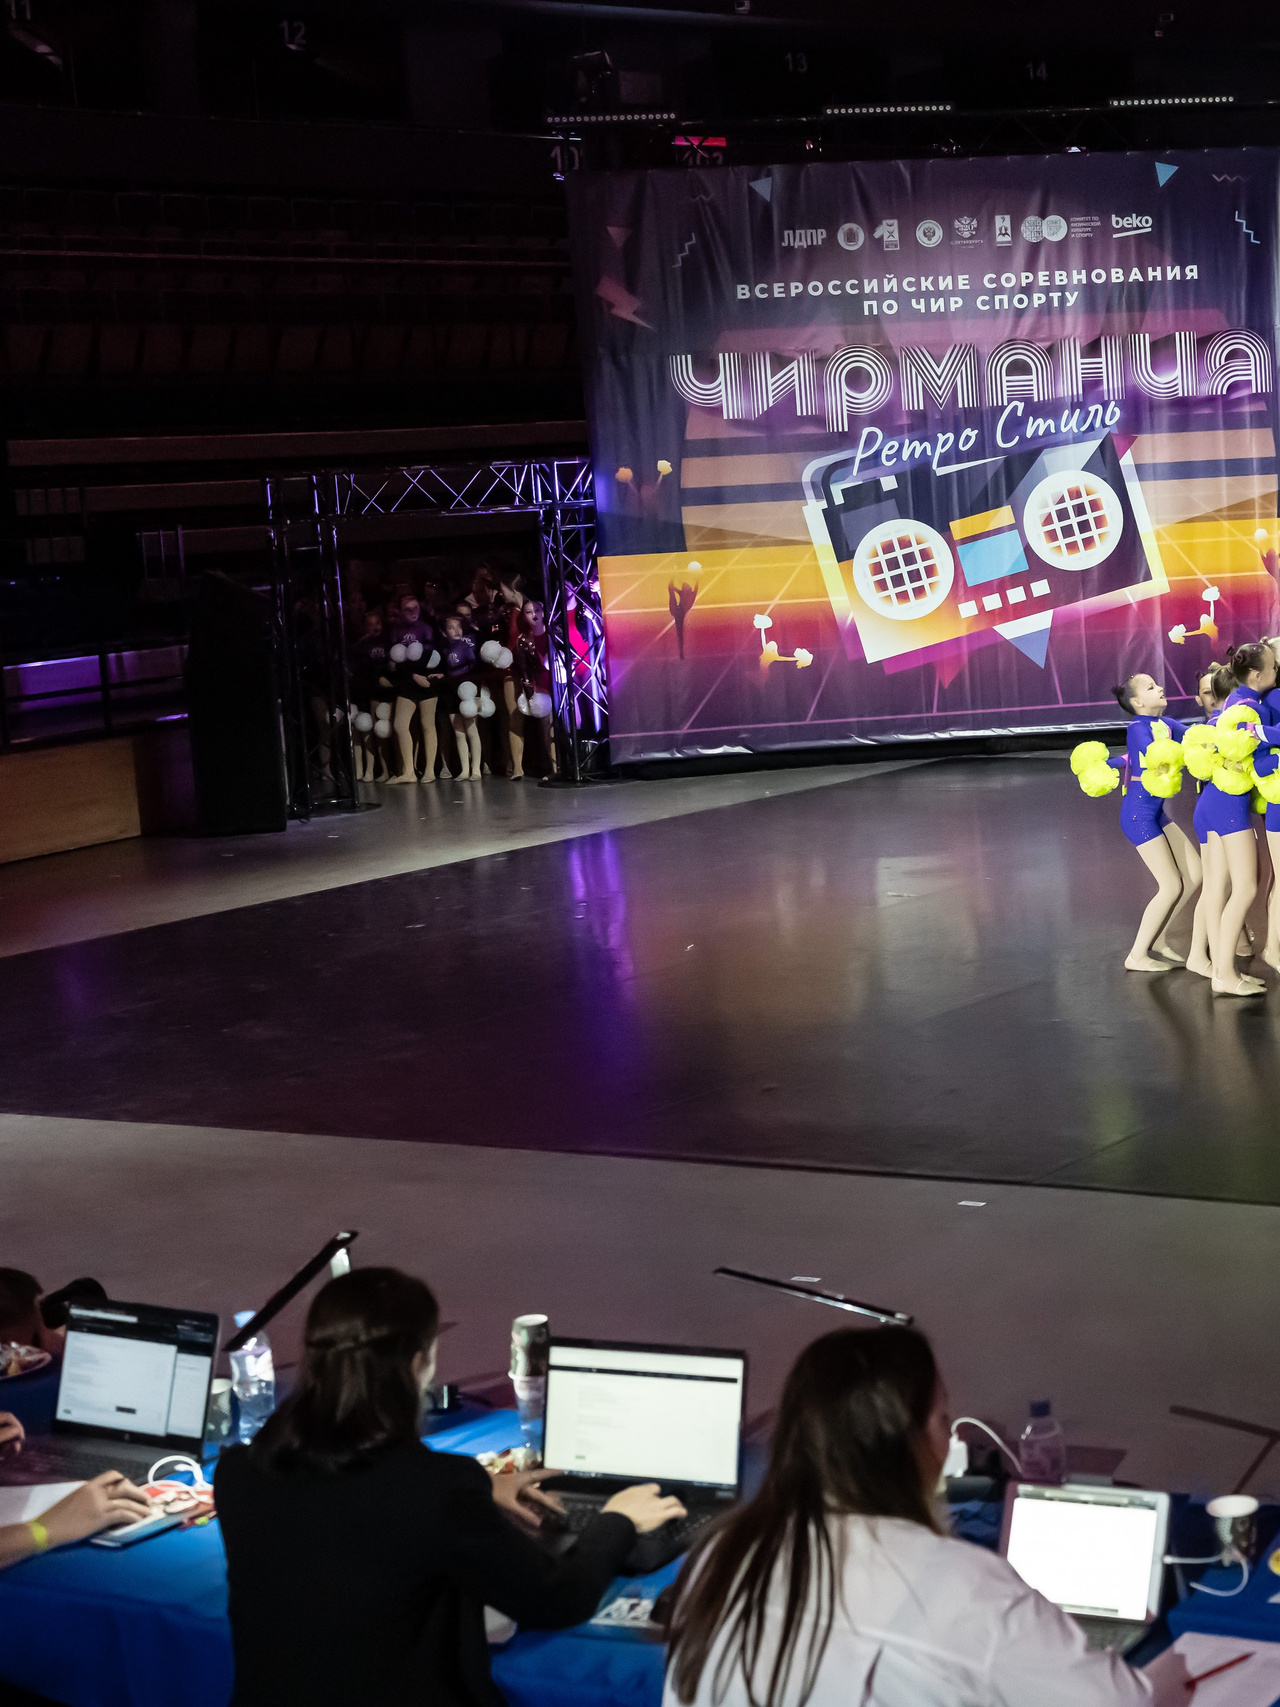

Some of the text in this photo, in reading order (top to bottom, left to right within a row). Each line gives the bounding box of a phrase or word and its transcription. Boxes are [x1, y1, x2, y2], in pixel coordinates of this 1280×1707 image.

[280, 20, 306, 44] 12
[785, 51, 808, 73] 13
[1025, 60, 1049, 81] 14
[1111, 213, 1153, 229] beko
[782, 229, 827, 249] ЛДПР
[736, 265, 1200, 300] ВСЕРОССИЙСКИЕ СОРЕВНОВАНИЯ
[863, 291, 1079, 316] ПО ЧИР СПОРТУ
[853, 400, 1121, 476] Ретро Стиль
